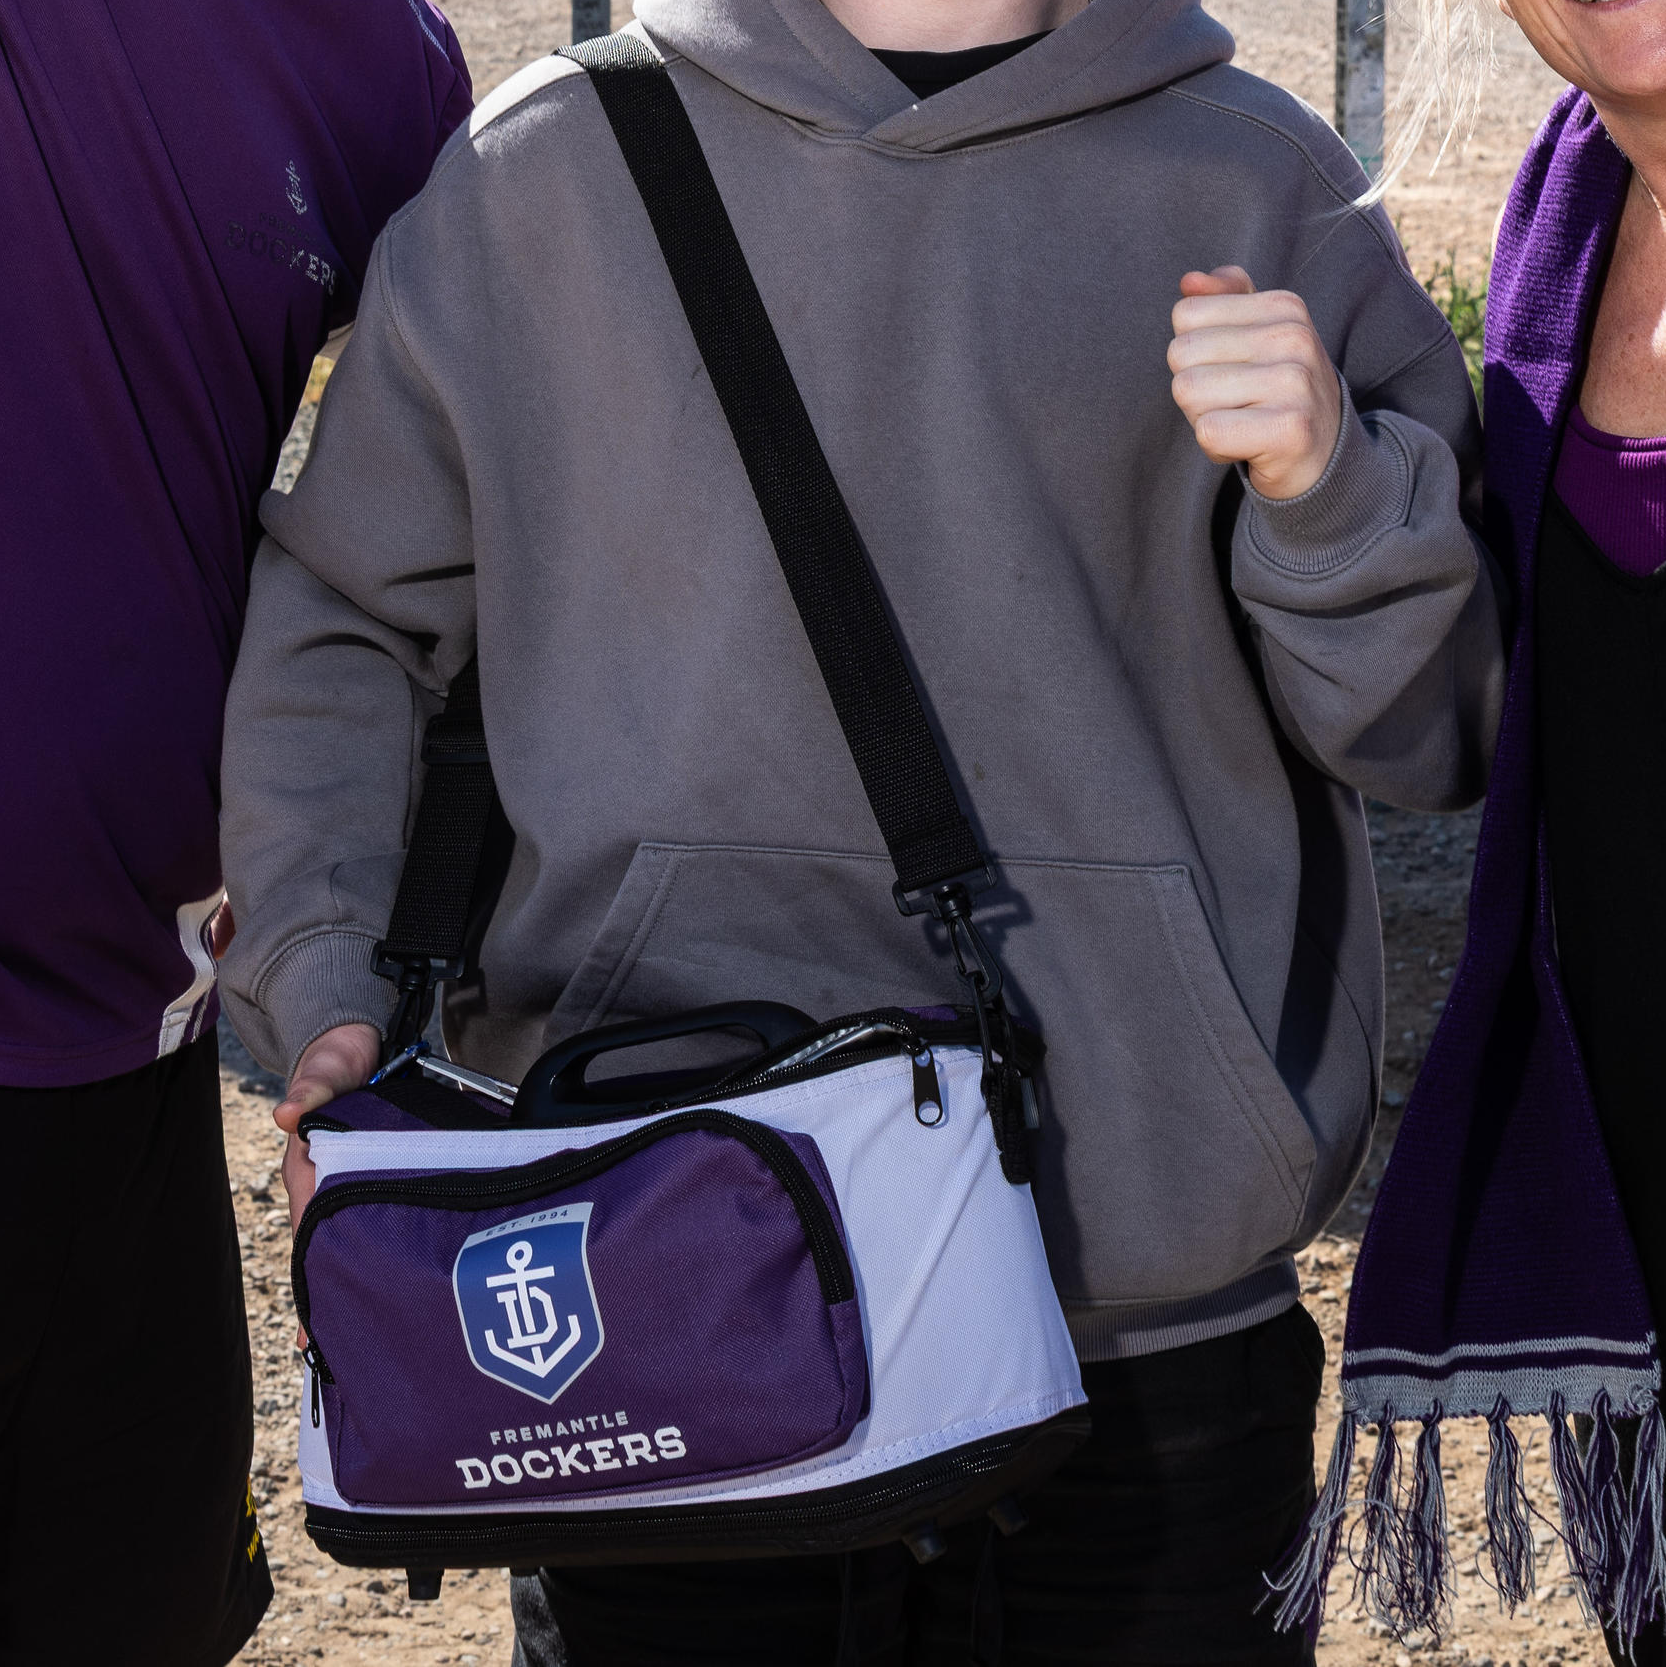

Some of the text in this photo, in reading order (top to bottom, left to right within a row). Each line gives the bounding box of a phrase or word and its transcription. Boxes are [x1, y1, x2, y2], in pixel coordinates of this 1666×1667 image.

[485, 1209, 569, 1237] EST. 1994
[489, 1410, 630, 1446] FREMANTLE
[455, 1425, 688, 1490] DOCKERS
